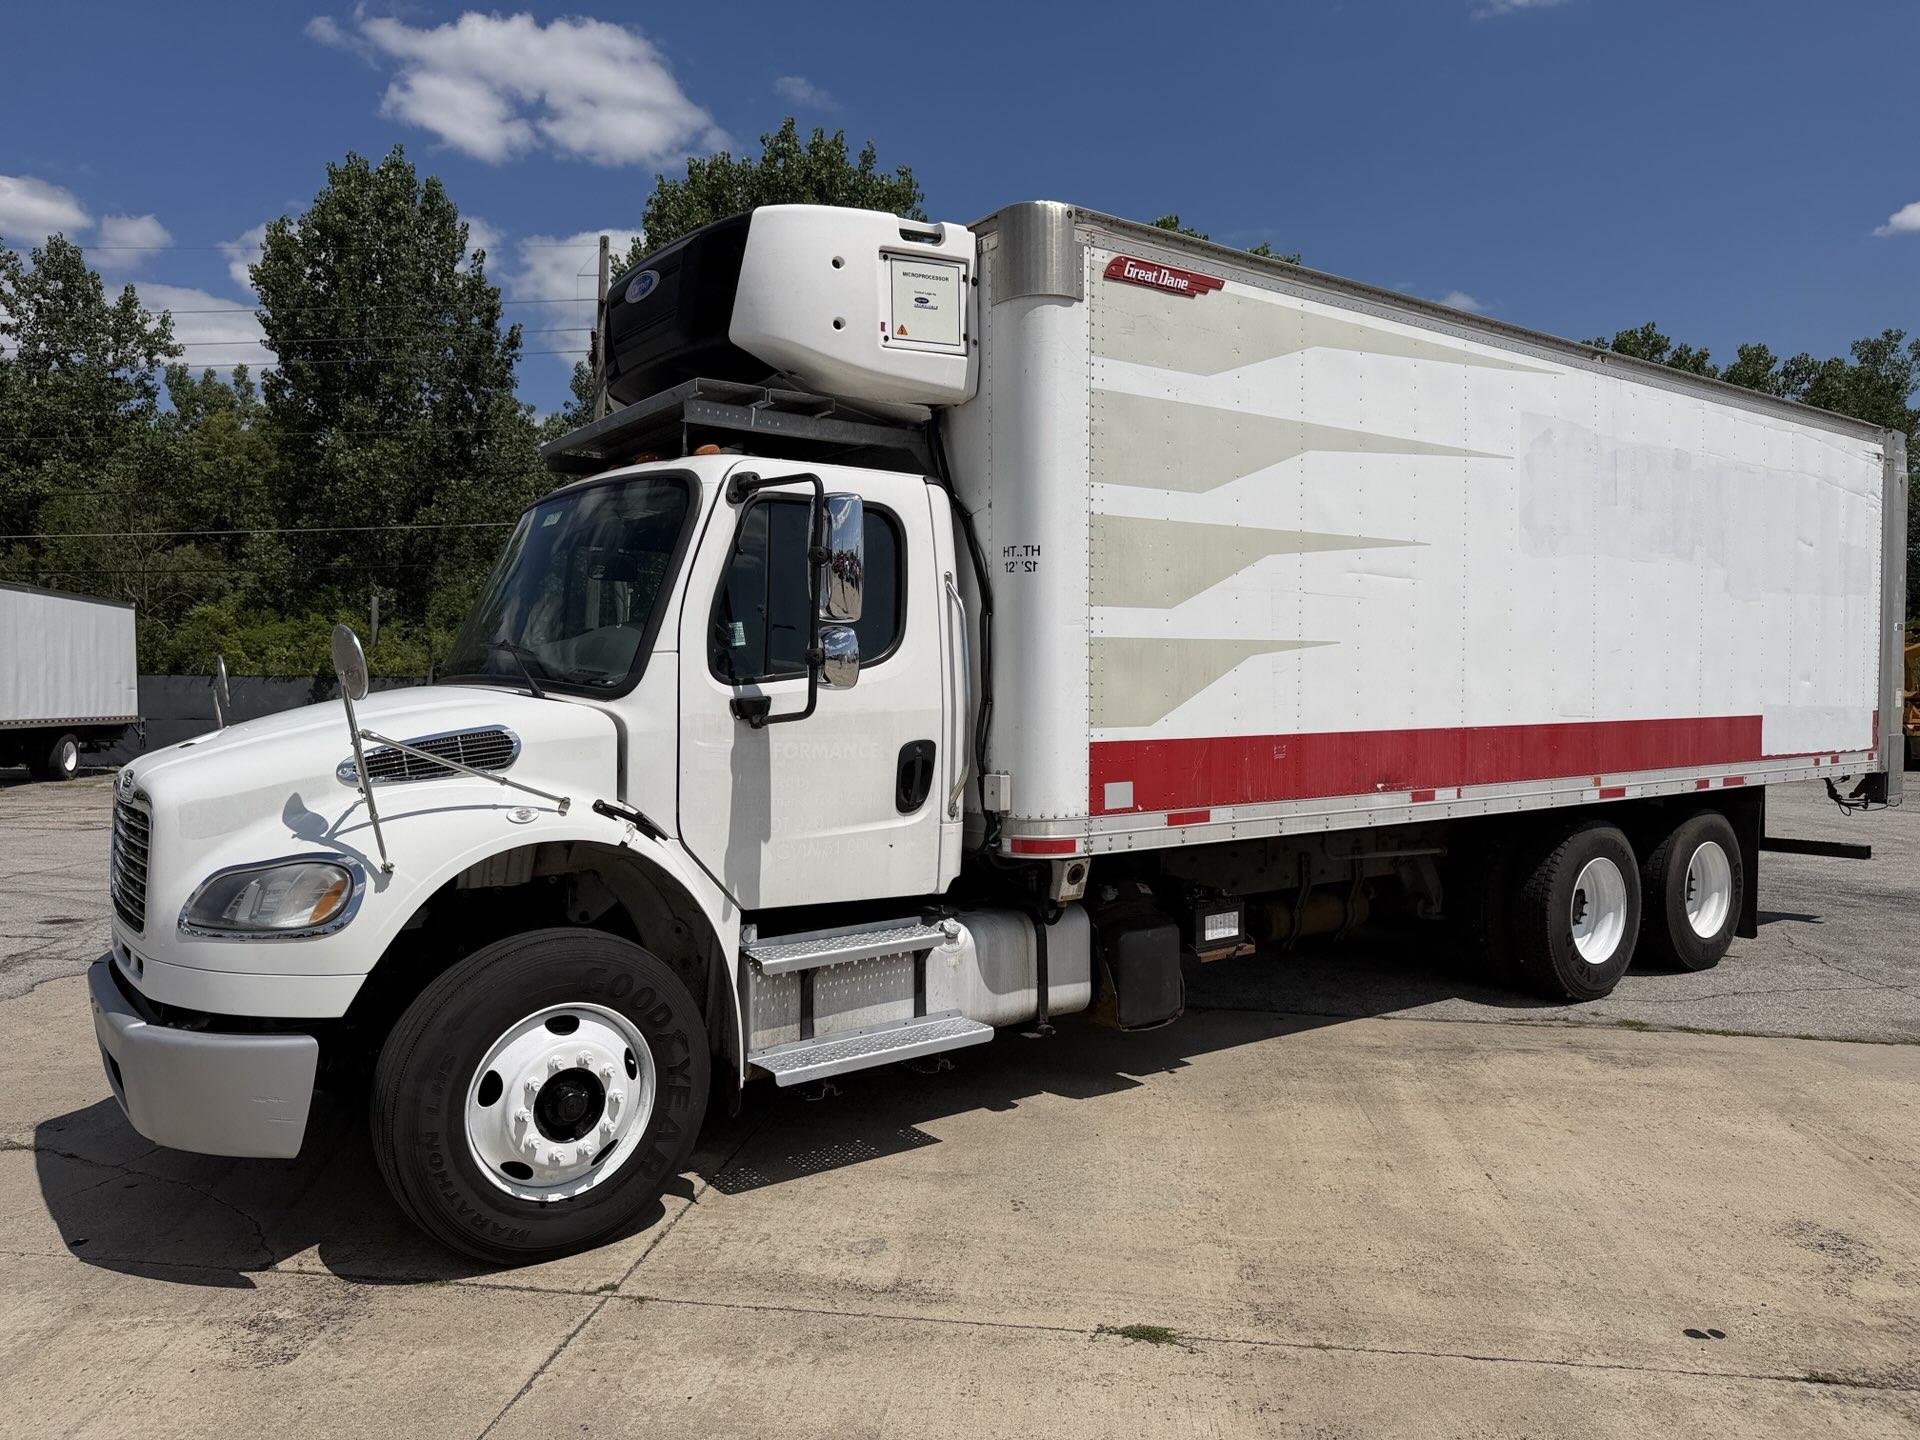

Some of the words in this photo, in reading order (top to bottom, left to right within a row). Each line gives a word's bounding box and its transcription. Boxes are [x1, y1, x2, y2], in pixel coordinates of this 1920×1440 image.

[902, 271, 950, 282] MICROPROCESSOR
[1123, 260, 1158, 283] Great
[1158, 268, 1189, 290] Dane
[577, 966, 692, 1178] GOODYEAR
